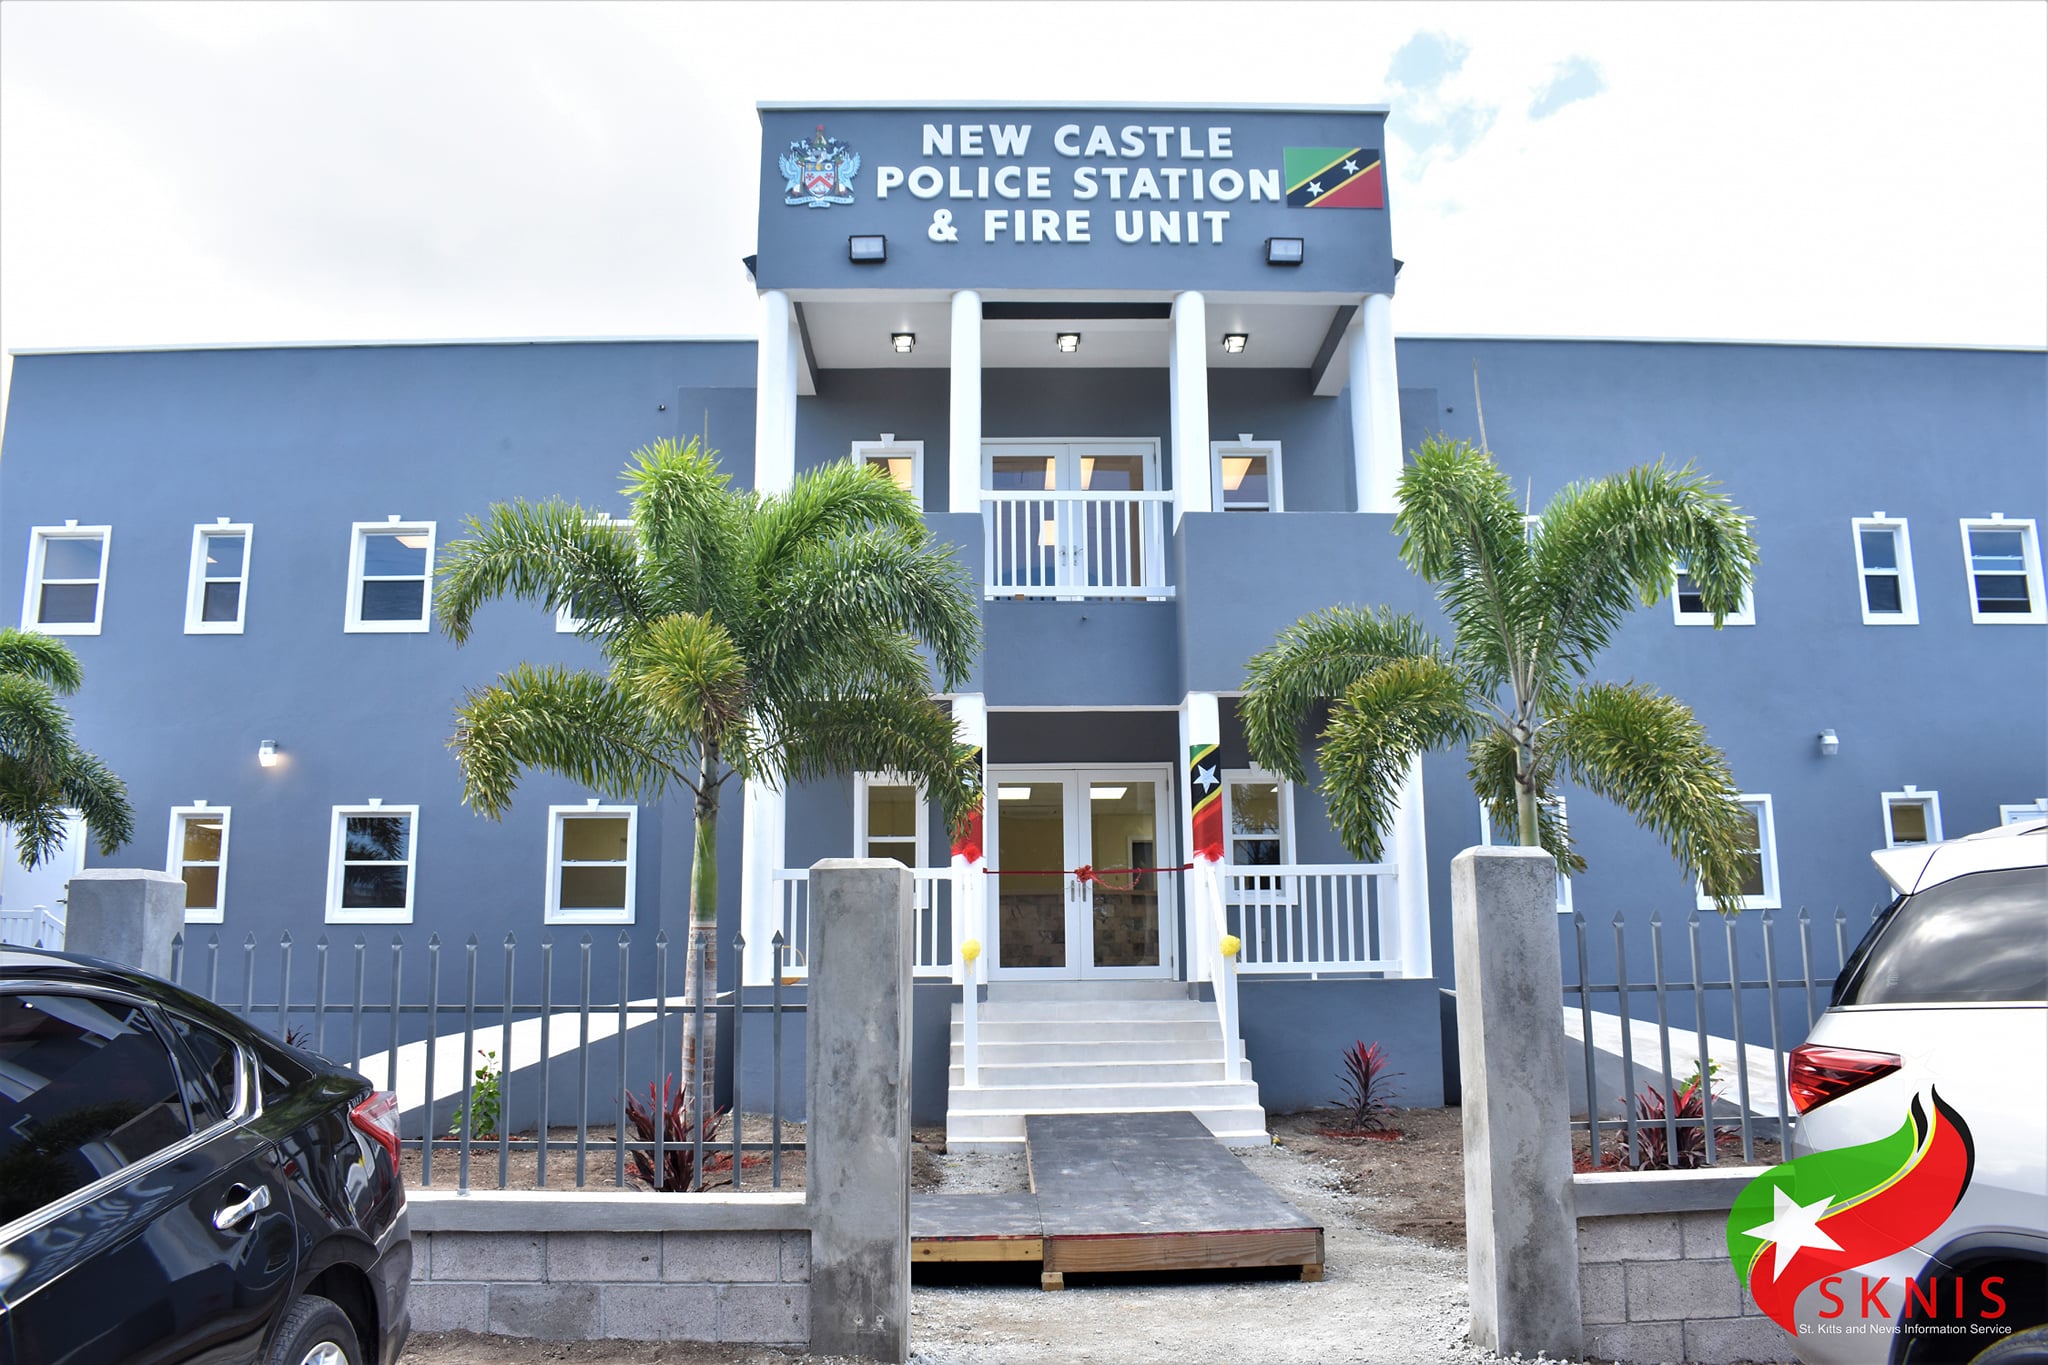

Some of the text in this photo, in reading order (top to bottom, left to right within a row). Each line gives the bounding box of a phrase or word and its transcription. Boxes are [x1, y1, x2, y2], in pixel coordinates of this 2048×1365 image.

[922, 124, 1233, 159] NEW CASTLE
[876, 165, 1282, 202] POLICE STATION
[927, 208, 1231, 244] & FIRE UNIT
